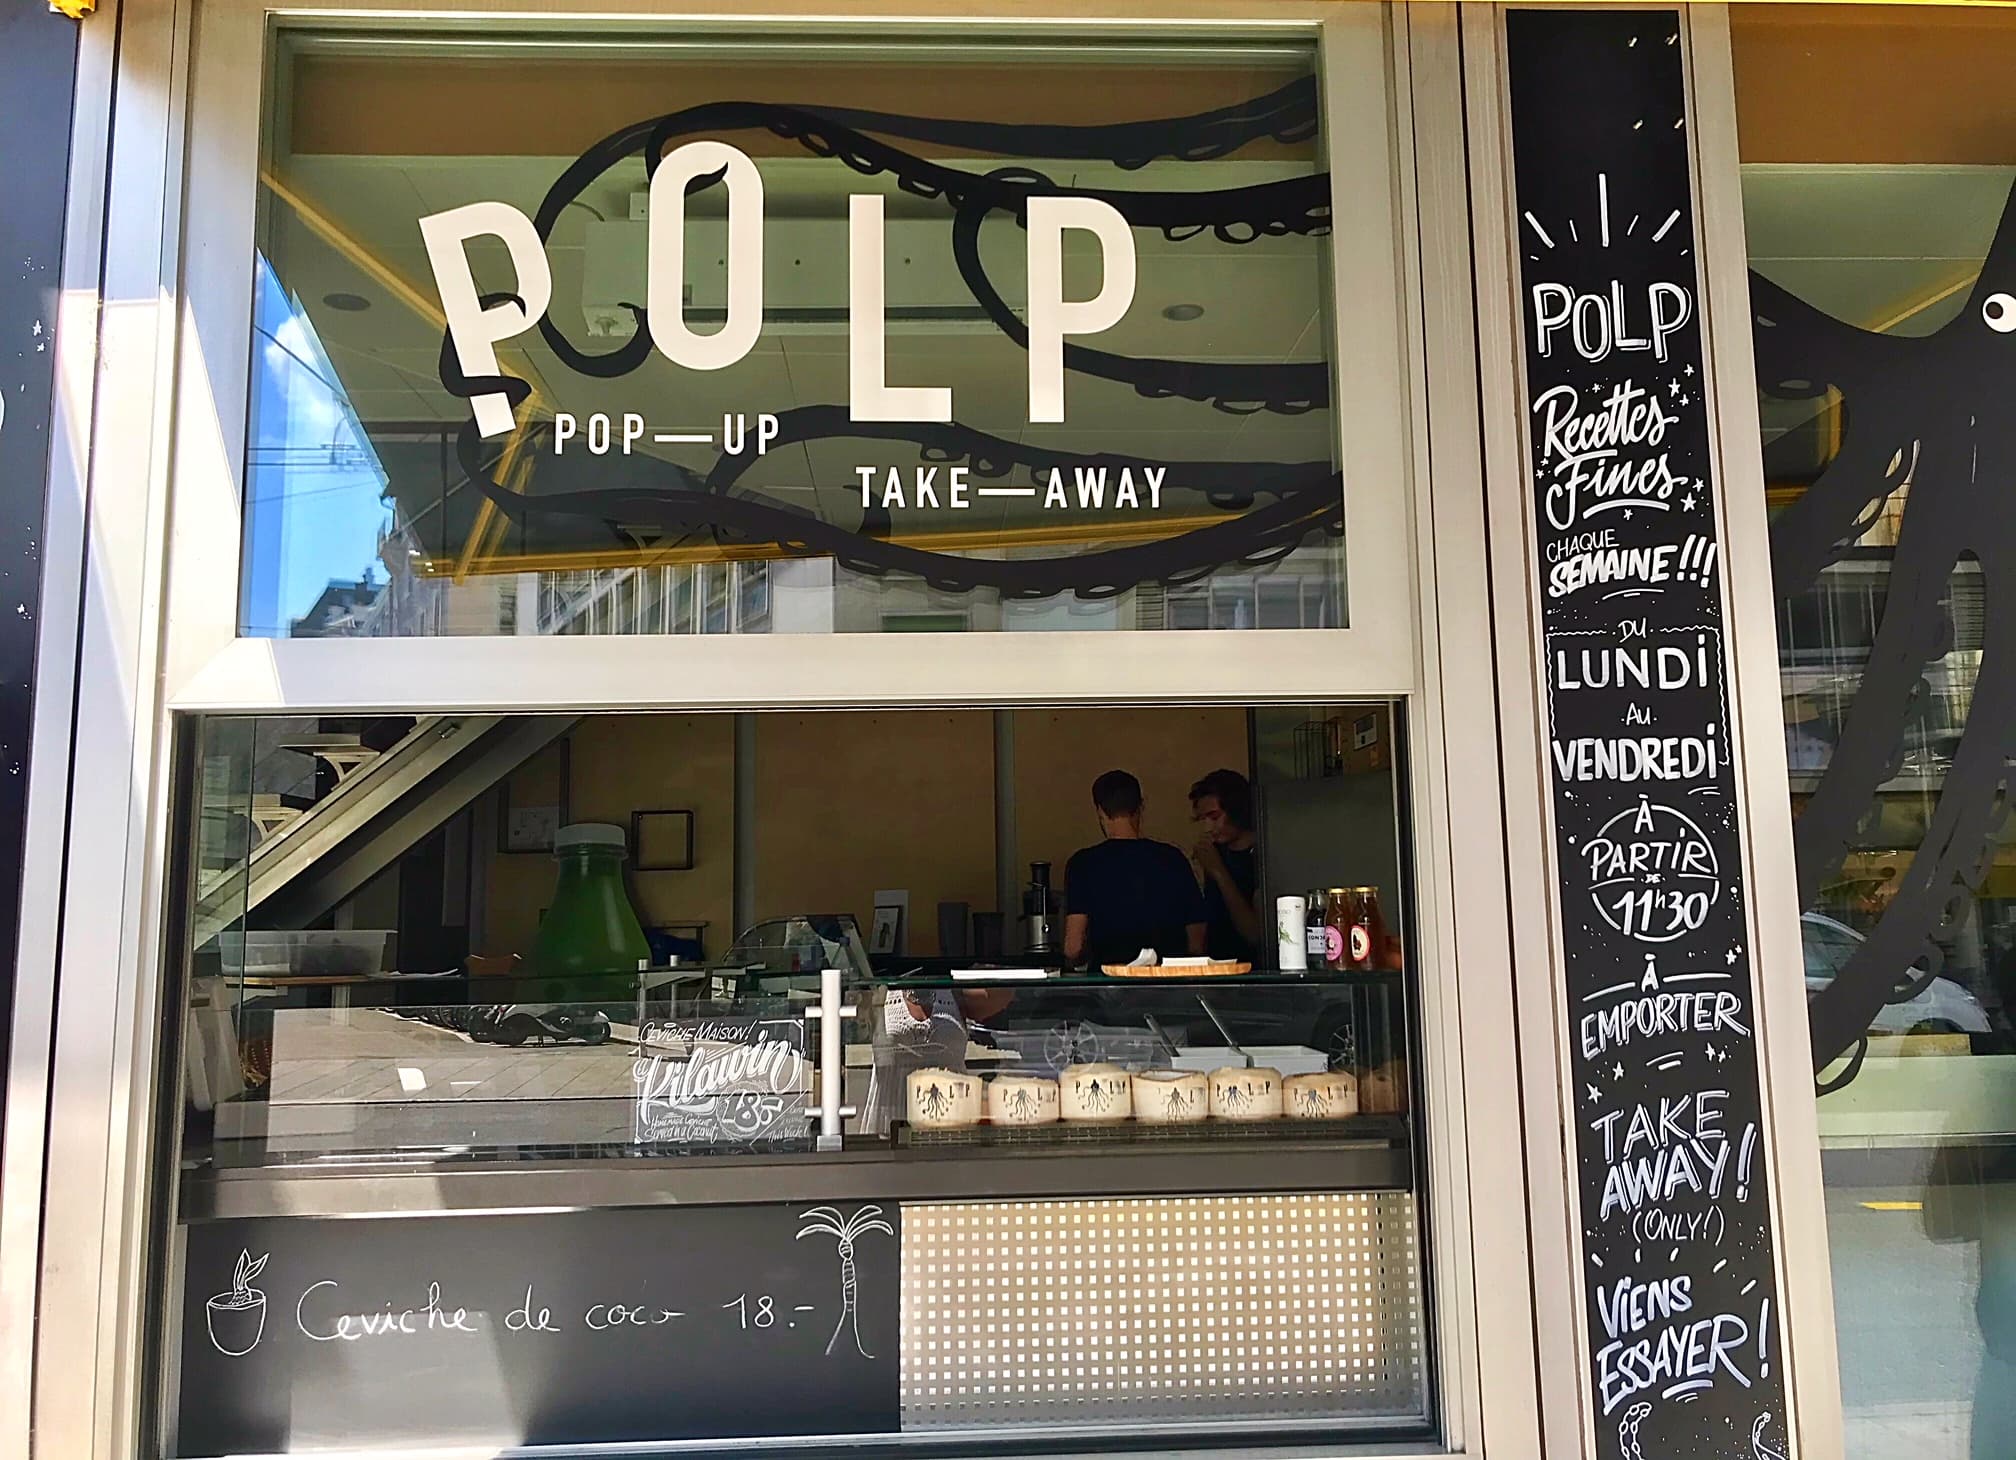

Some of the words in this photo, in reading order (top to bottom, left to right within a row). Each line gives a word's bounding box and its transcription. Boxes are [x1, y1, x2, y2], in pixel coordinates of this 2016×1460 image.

[419, 141, 1137, 440] POLP
[1532, 279, 1691, 363] POLP
[1533, 379, 1679, 459] Recettes
[1546, 449, 1688, 531] Fines
[1546, 529, 1620, 564] CHAQUE
[1618, 618, 1647, 643] DU
[1612, 889, 1708, 936] 11h30
[1581, 992, 1751, 1061] EMPORTER
[1591, 1090, 1730, 1165] TAKE
[1632, 1205, 1725, 1246] (ONLY!)
[297, 1280, 481, 1342] Ceviche
[504, 1284, 561, 1333] de
